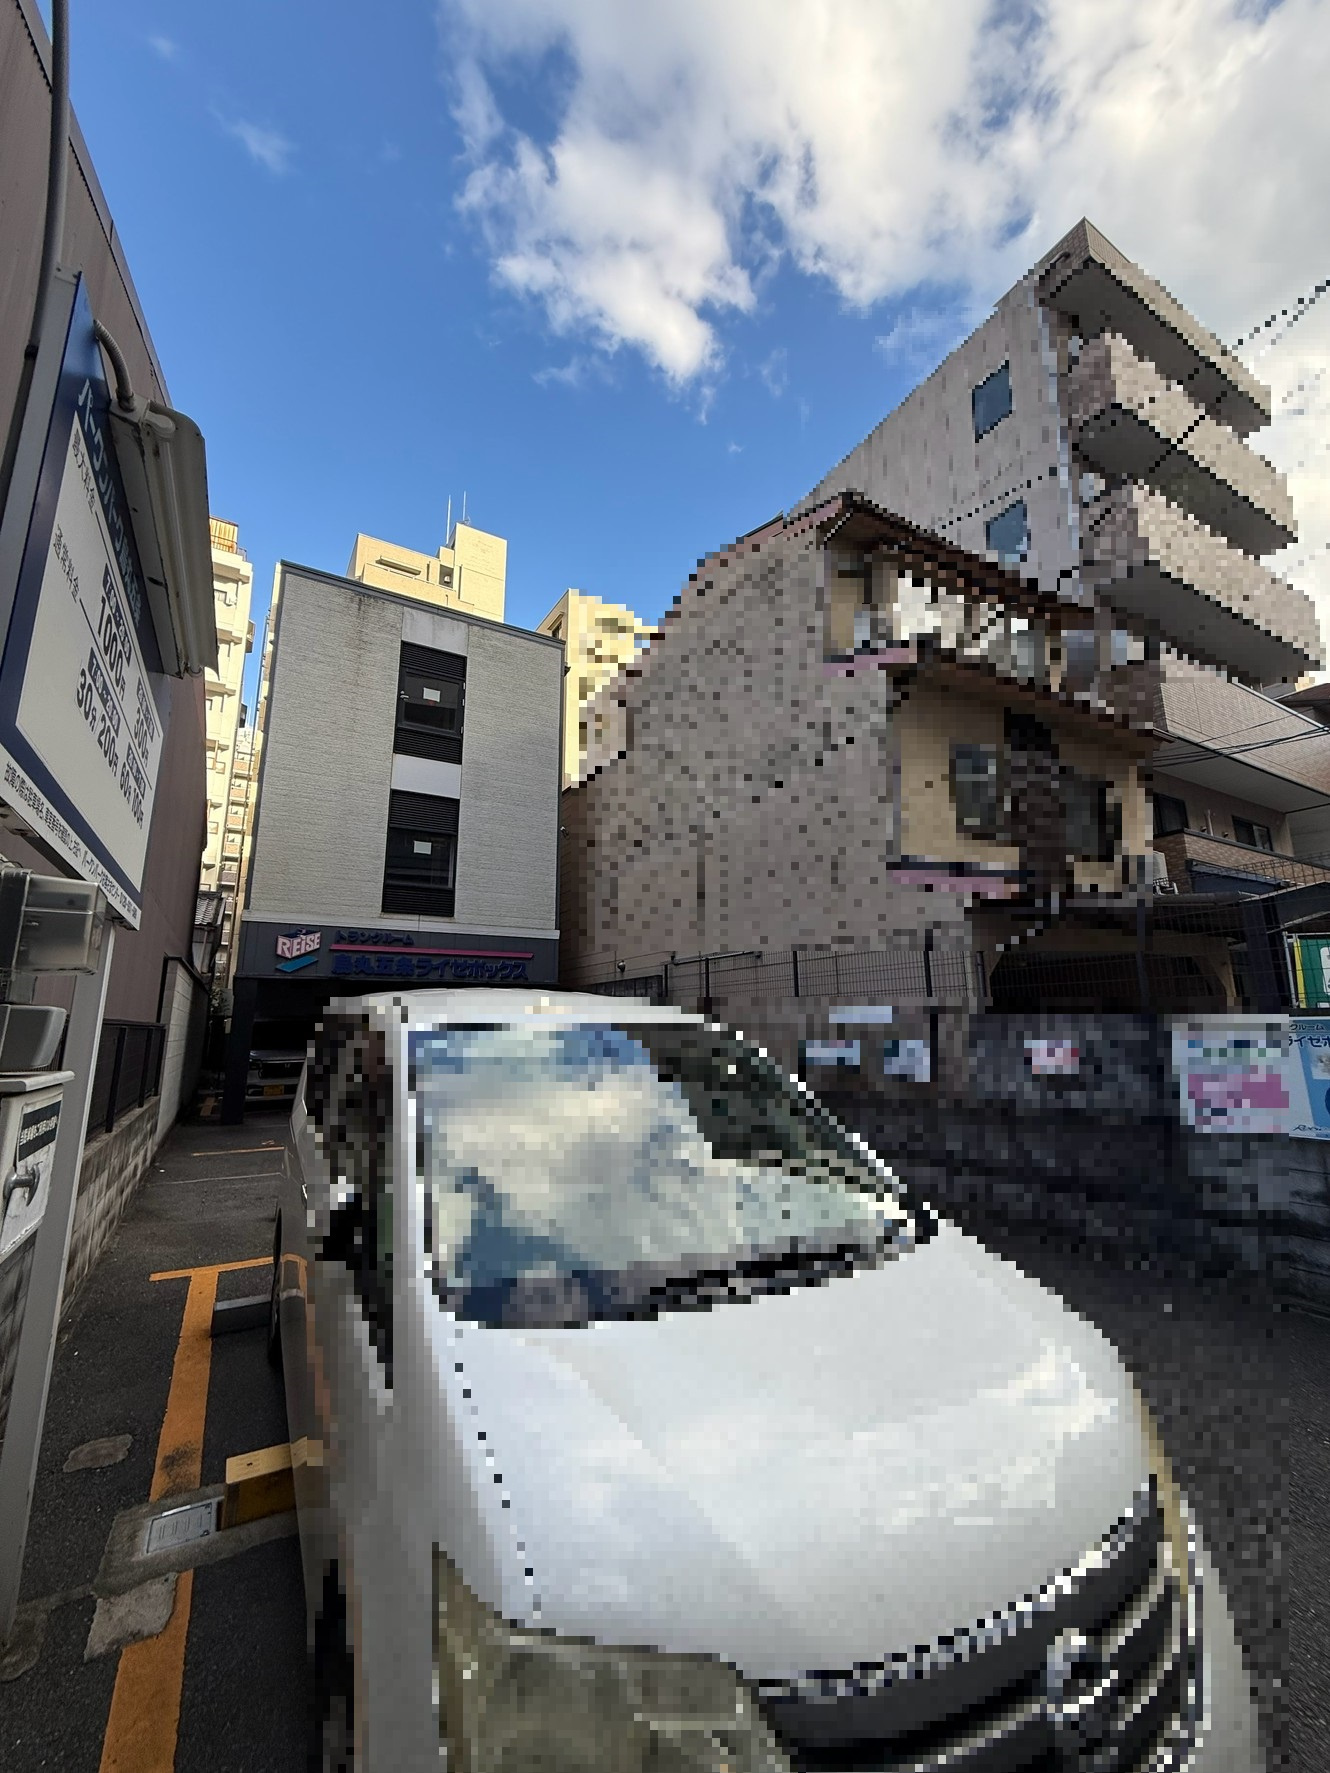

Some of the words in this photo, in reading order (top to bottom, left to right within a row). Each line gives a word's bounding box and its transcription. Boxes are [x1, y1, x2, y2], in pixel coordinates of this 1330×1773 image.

[72, 428, 95, 514] 最大料金
[54, 524, 80, 603] 通常料金
[97, 595, 126, 701] 1000円
[134, 707, 150, 768] 300円
[335, 930, 414, 945] トランクルーム
